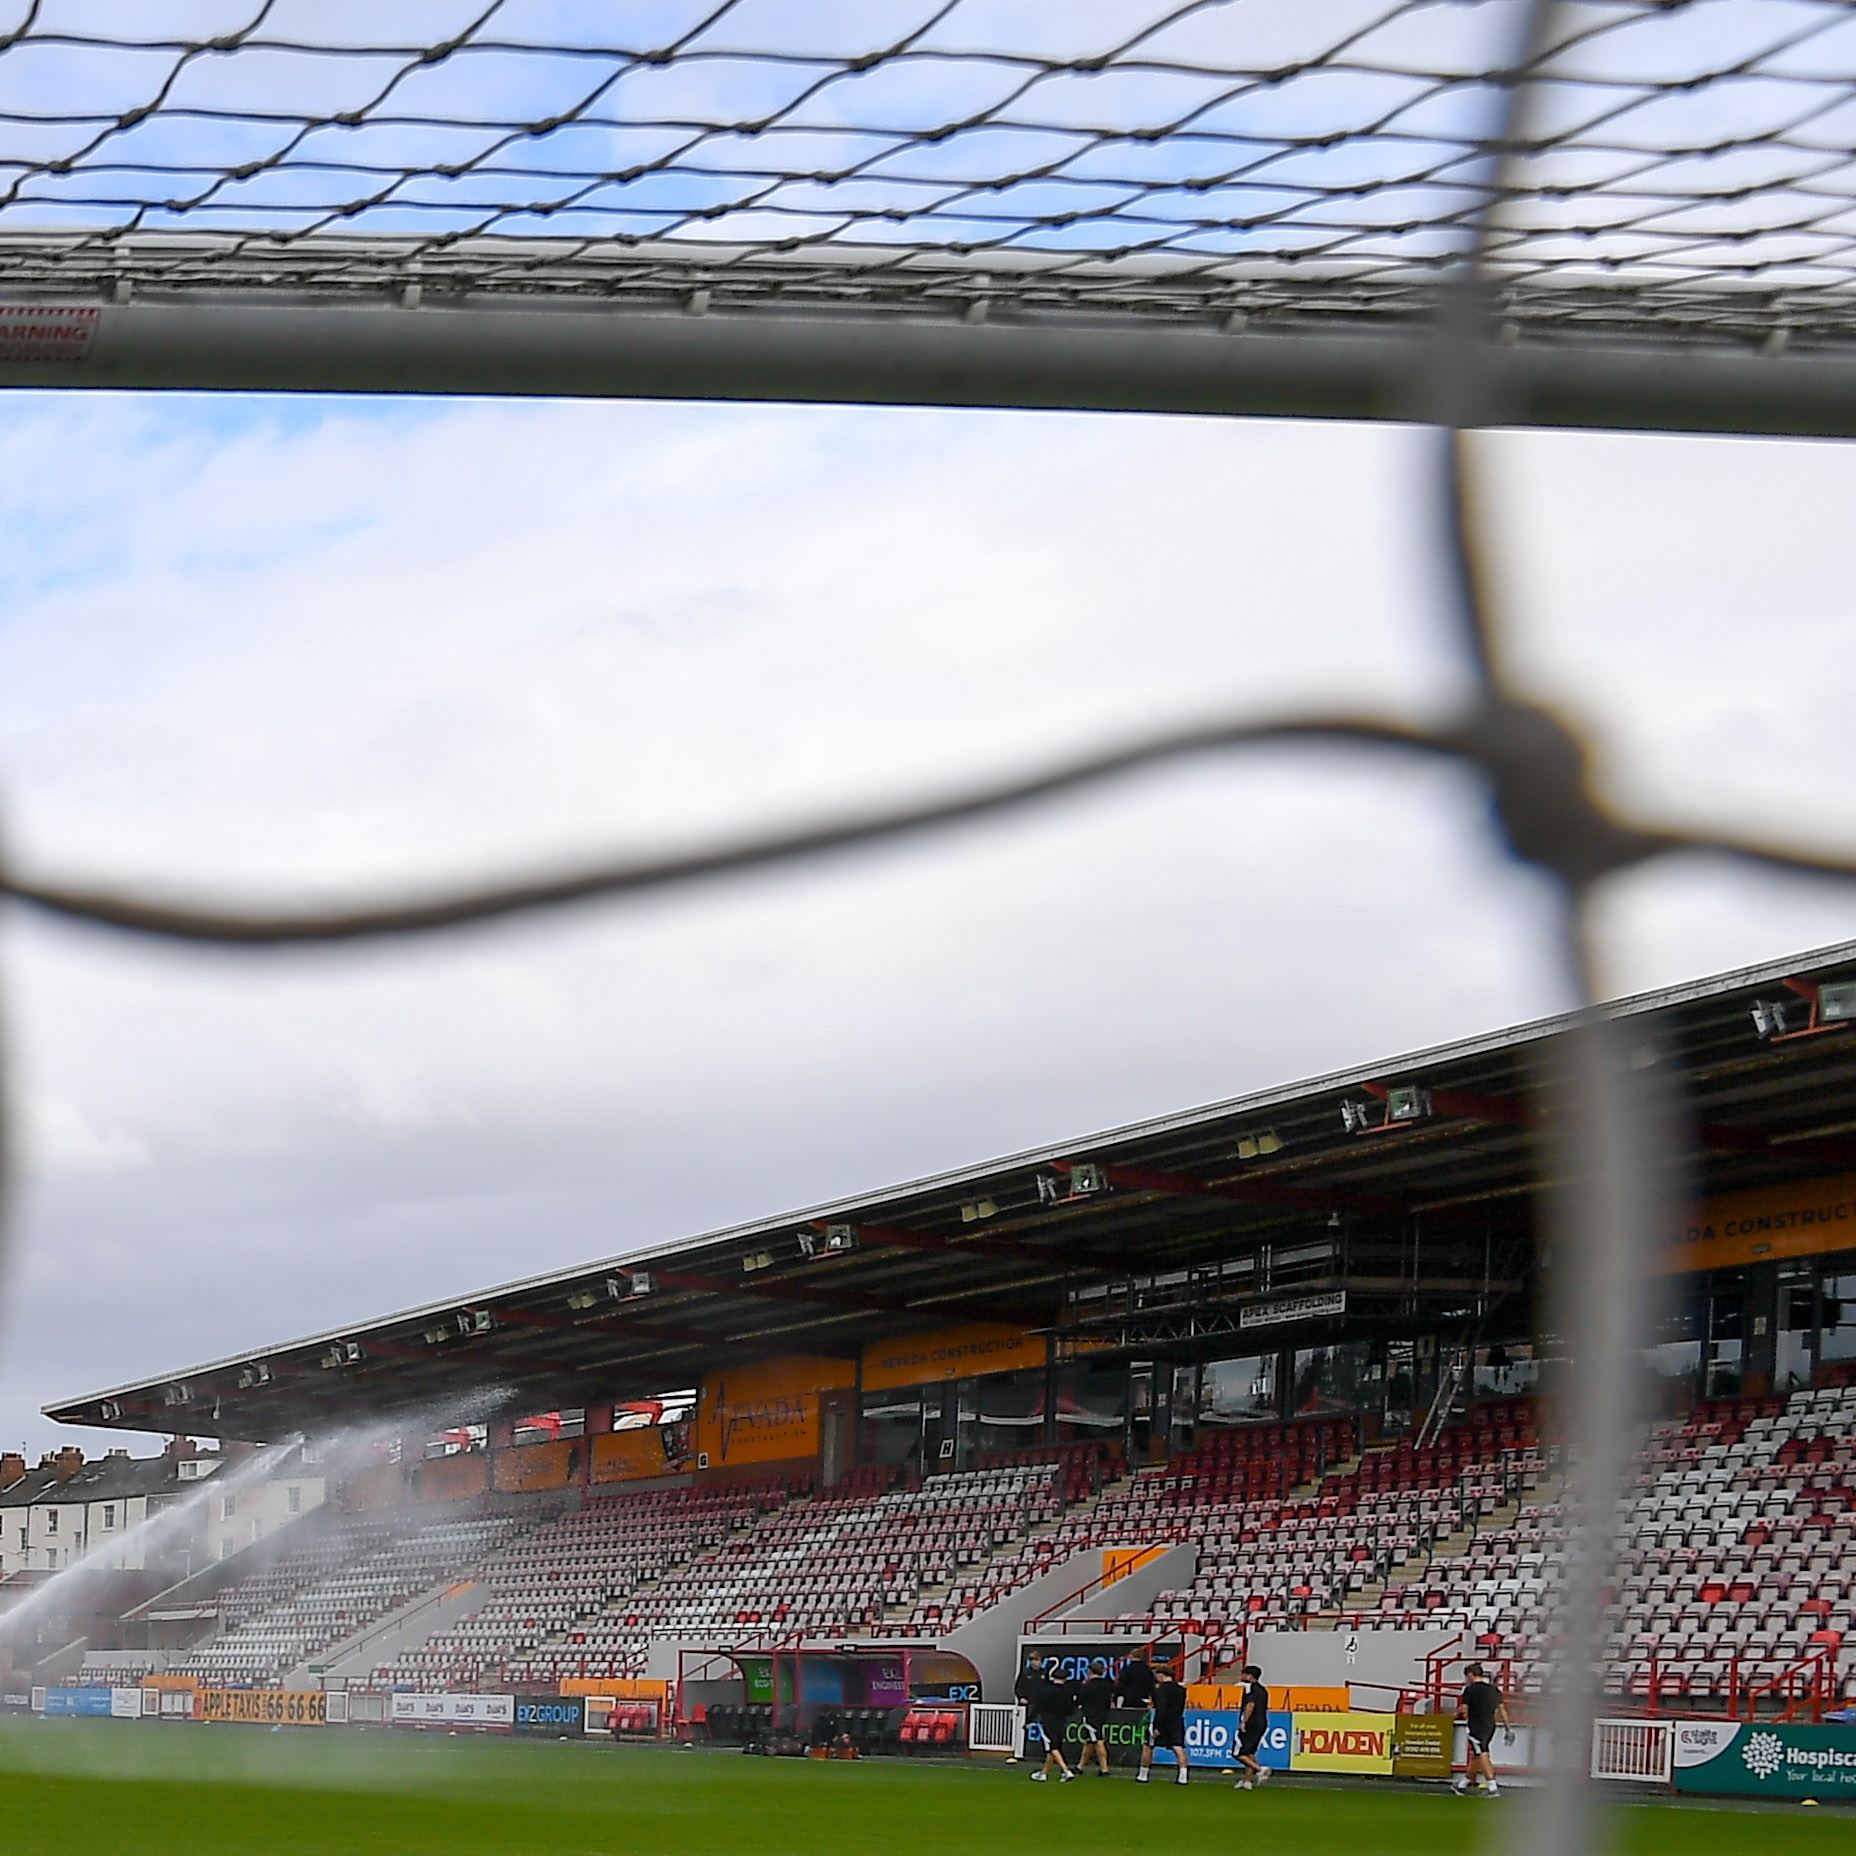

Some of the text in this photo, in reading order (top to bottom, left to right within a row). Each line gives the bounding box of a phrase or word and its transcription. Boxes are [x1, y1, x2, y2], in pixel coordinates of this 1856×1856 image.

[1724, 1202, 1856, 1238] CONSTRUC
[1272, 1293, 1342, 1315] SCAFFOLDING
[880, 1337, 1025, 1369] NEVADA CONSTRUCTION
[203, 1692, 232, 1718] APPLE
[233, 1692, 261, 1718] TAXIS
[949, 1686, 980, 1701] EX2
[518, 1704, 580, 1723] EX2GROUP
[1185, 1719, 1229, 1748] dio
[1300, 1730, 1385, 1756] HOWDEN
[1787, 1769, 1808, 1782] Your
[1812, 1769, 1836, 1783] local
